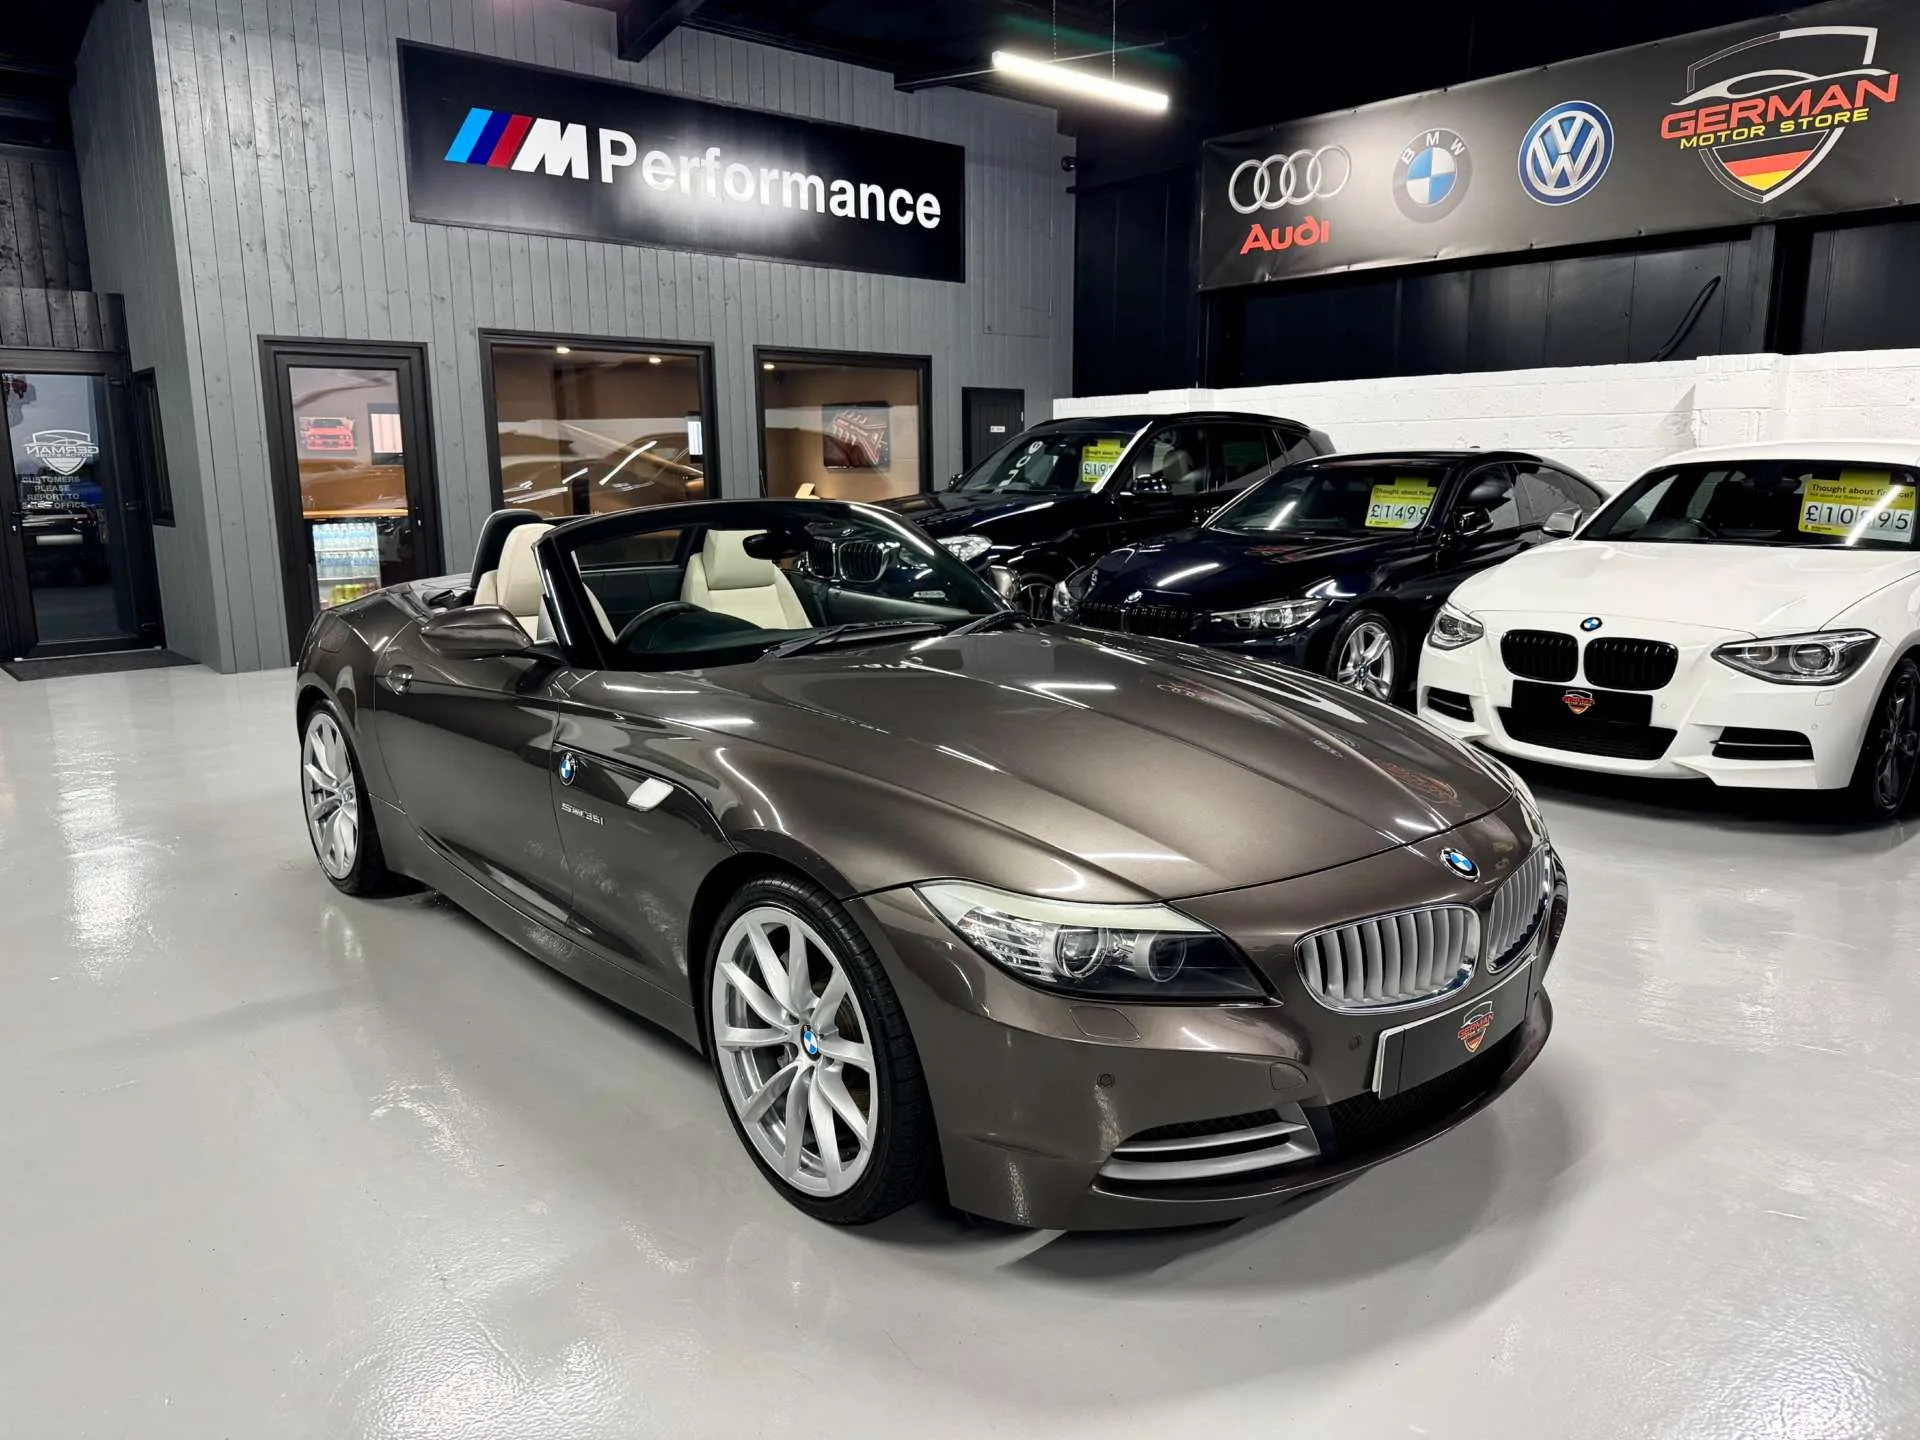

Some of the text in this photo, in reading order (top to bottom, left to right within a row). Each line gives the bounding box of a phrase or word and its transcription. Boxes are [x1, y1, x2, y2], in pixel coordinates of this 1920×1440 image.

[1660, 73, 1899, 139] GERMAN
[1401, 131, 1466, 165] BMW
[1680, 107, 1870, 149] MOTOR STORE
[511, 117, 941, 230] M Performance
[1240, 215, 1330, 255] Audi
[34, 484, 71, 492] PLEASE
[1812, 484, 1846, 494] Thought
[1848, 487, 1874, 496] about
